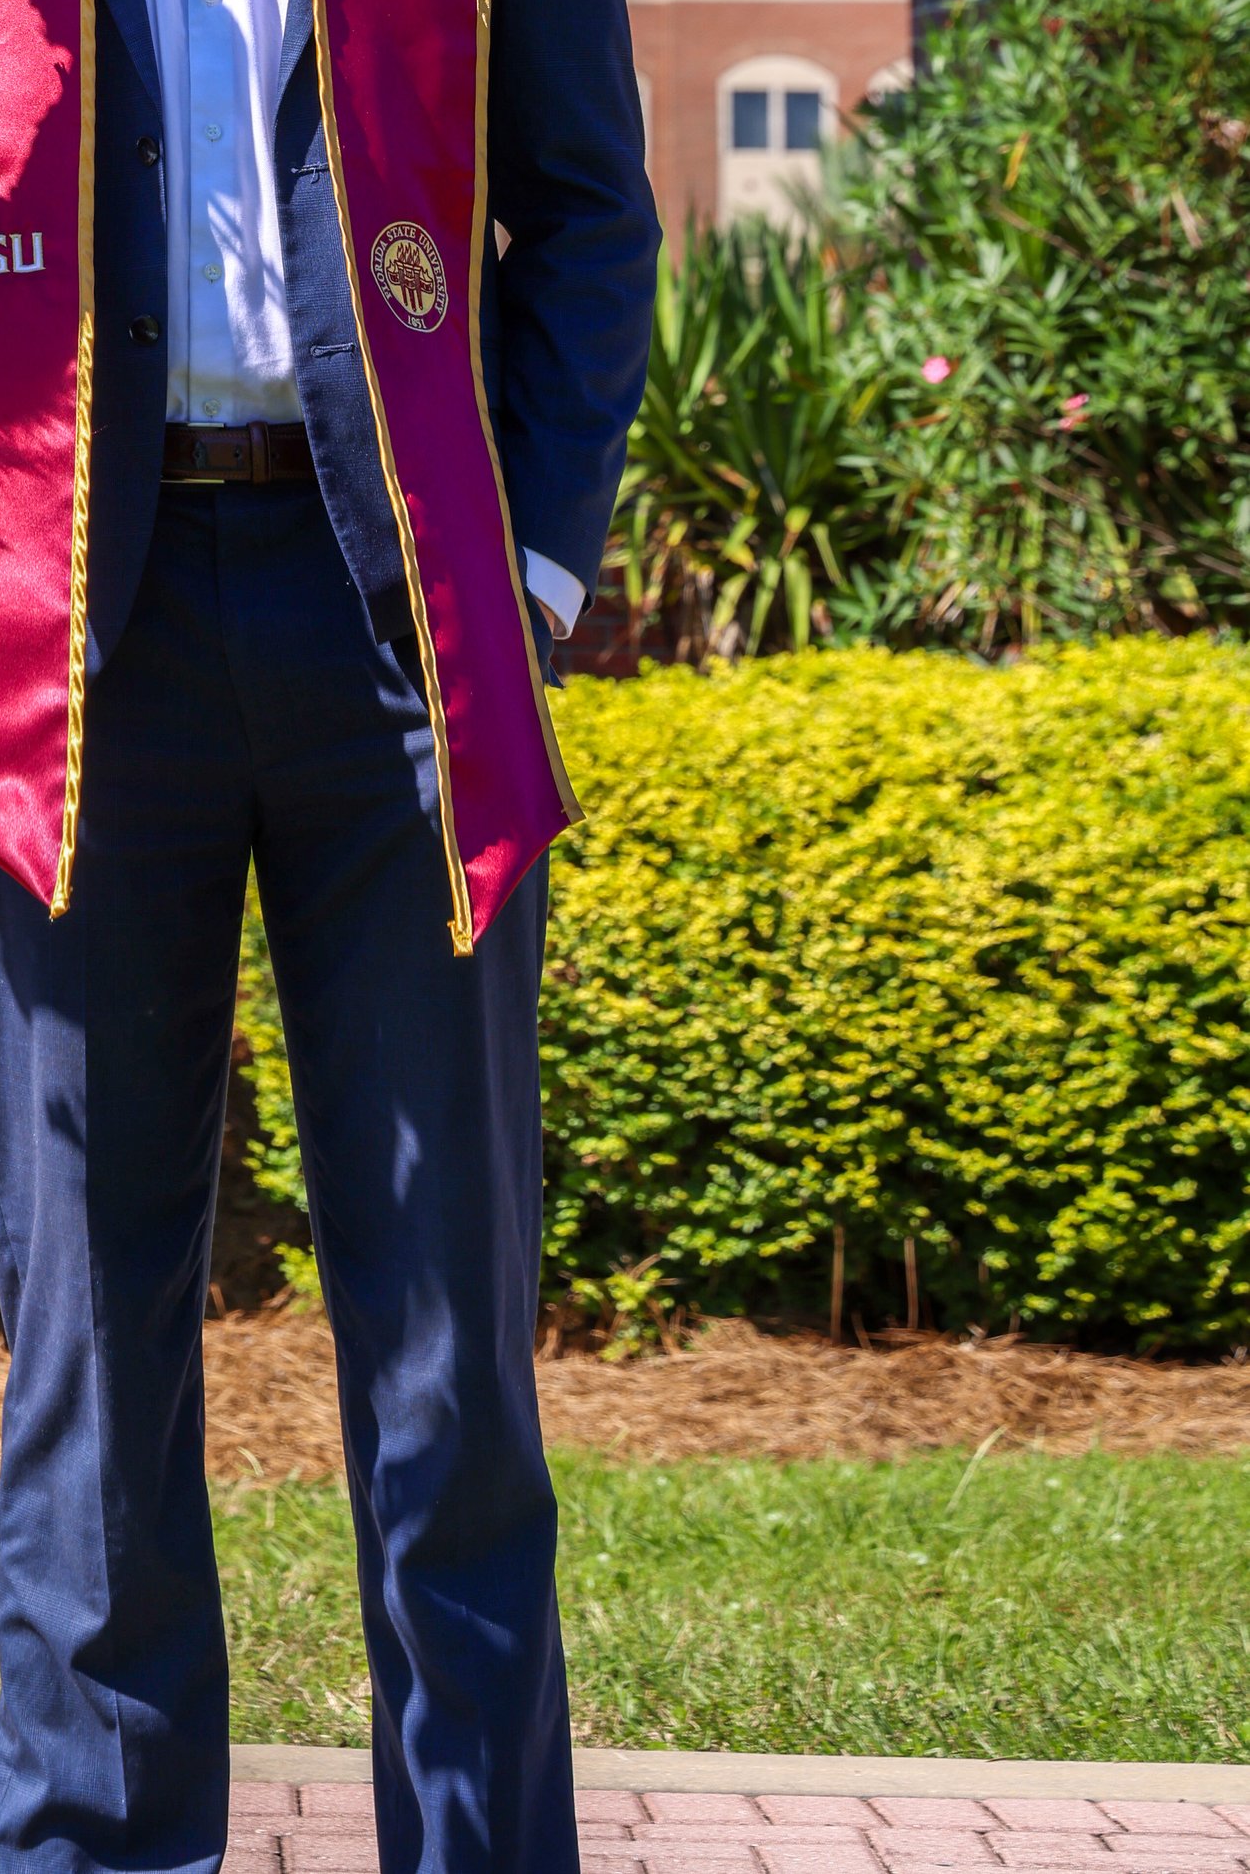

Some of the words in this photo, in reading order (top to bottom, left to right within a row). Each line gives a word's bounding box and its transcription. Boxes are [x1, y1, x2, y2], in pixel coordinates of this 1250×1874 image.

[373, 240, 393, 301] FLORIDA
[386, 225, 417, 242] STATE
[418, 233, 446, 315] UNIVERSITY
